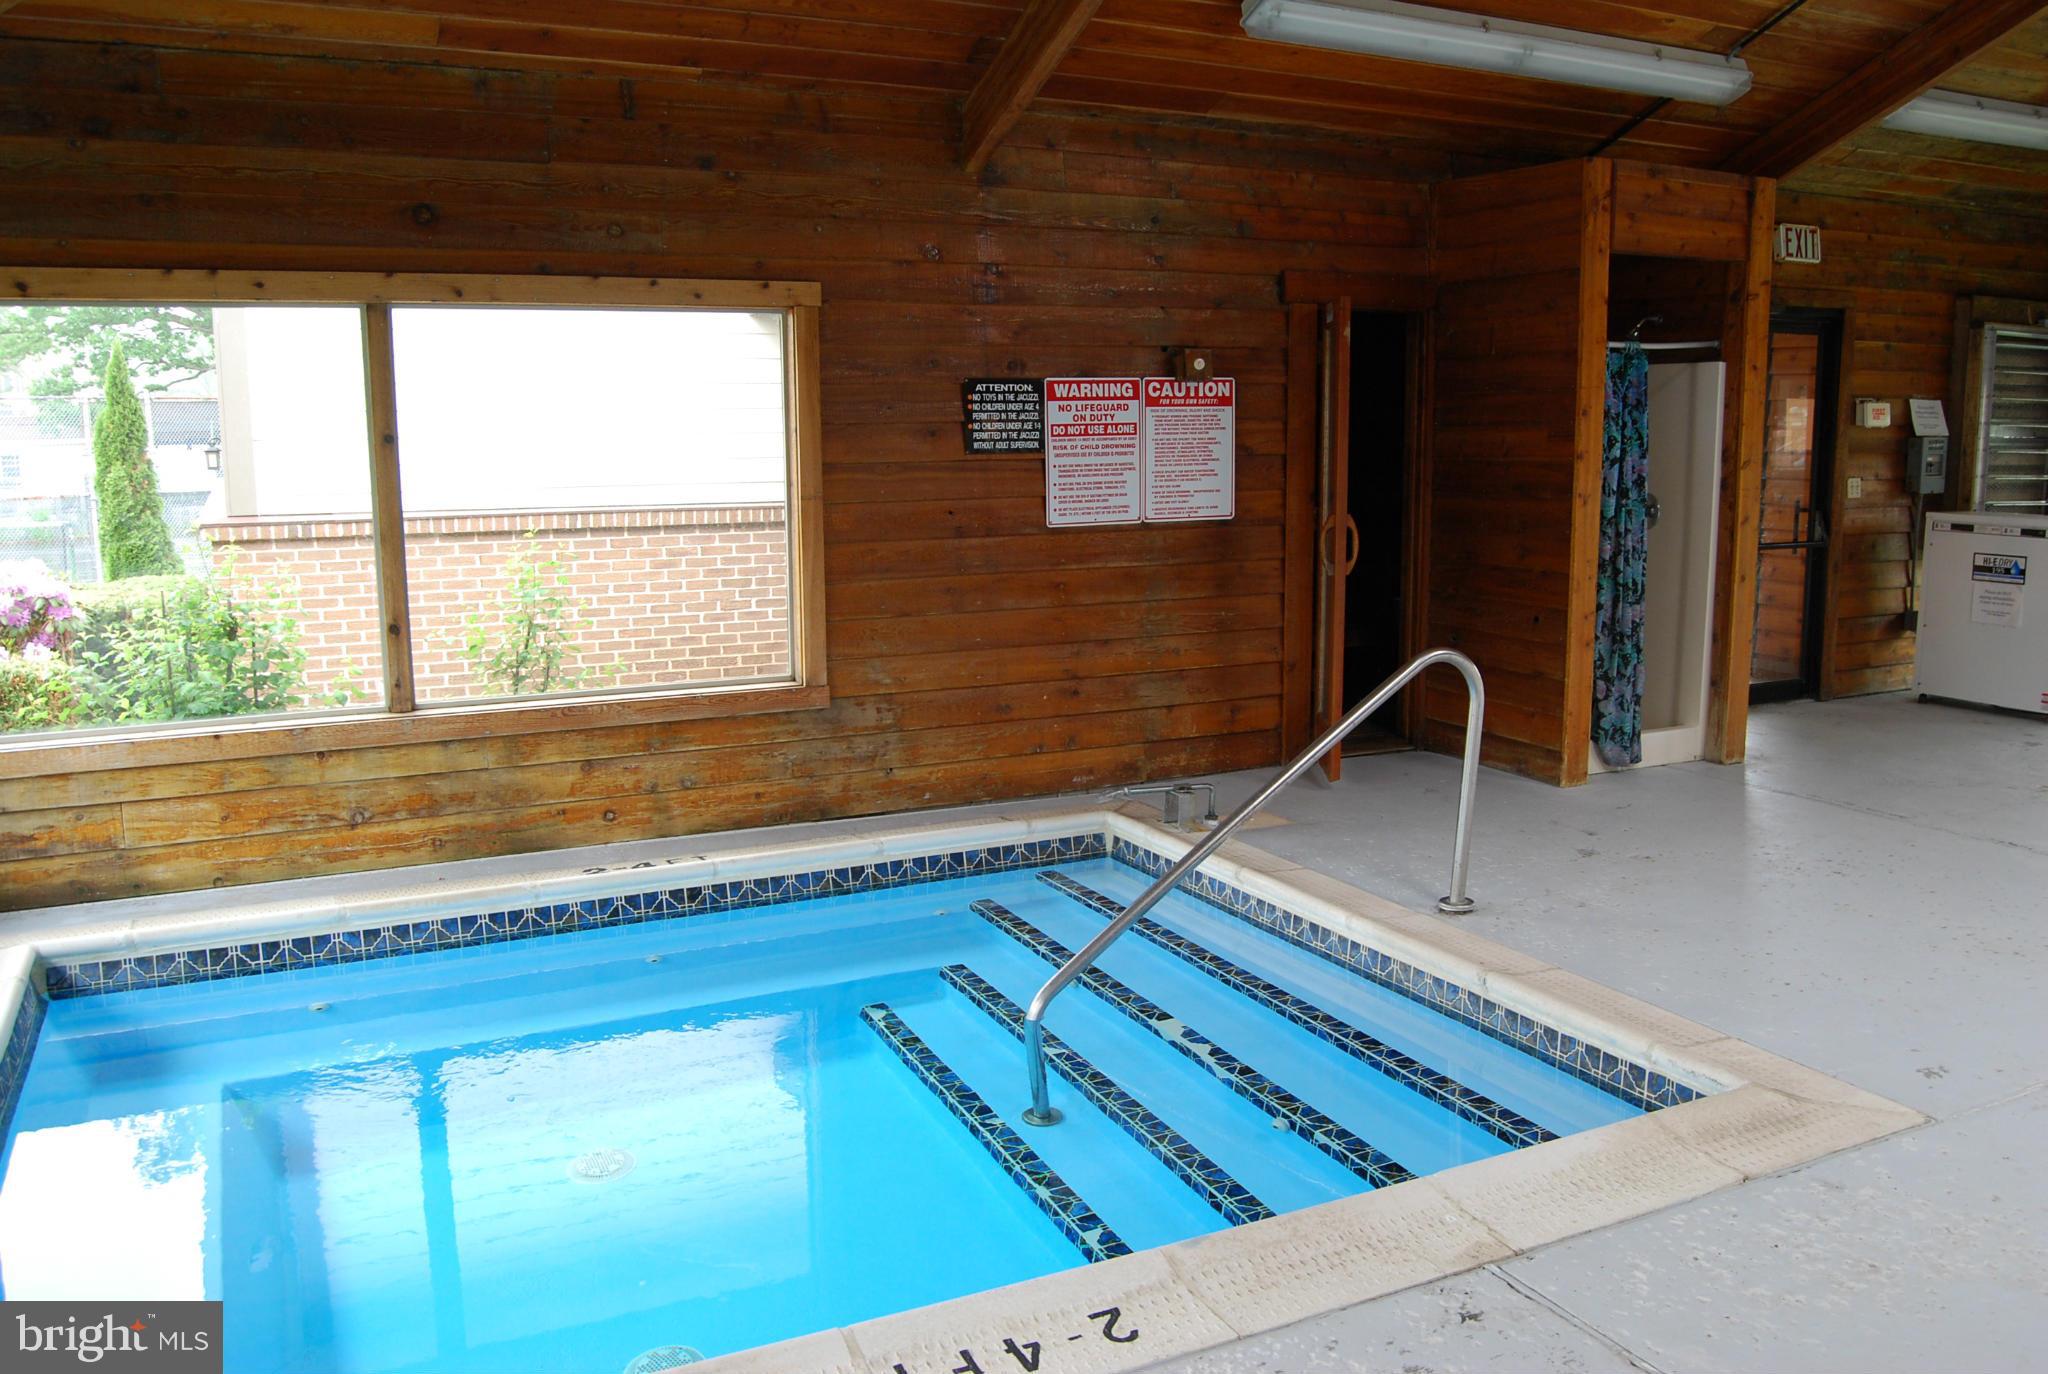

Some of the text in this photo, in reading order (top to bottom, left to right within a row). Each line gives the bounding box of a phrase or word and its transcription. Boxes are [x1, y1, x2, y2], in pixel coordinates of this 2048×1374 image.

[1785, 227, 1817, 258] EXIT
[1054, 383, 1133, 397] WARNING
[1148, 382, 1230, 397] CAUTION
[1058, 404, 1072, 412] NO
[1073, 414, 1086, 422] ON
[1053, 425, 1135, 435] DO NOT USE ALONE
